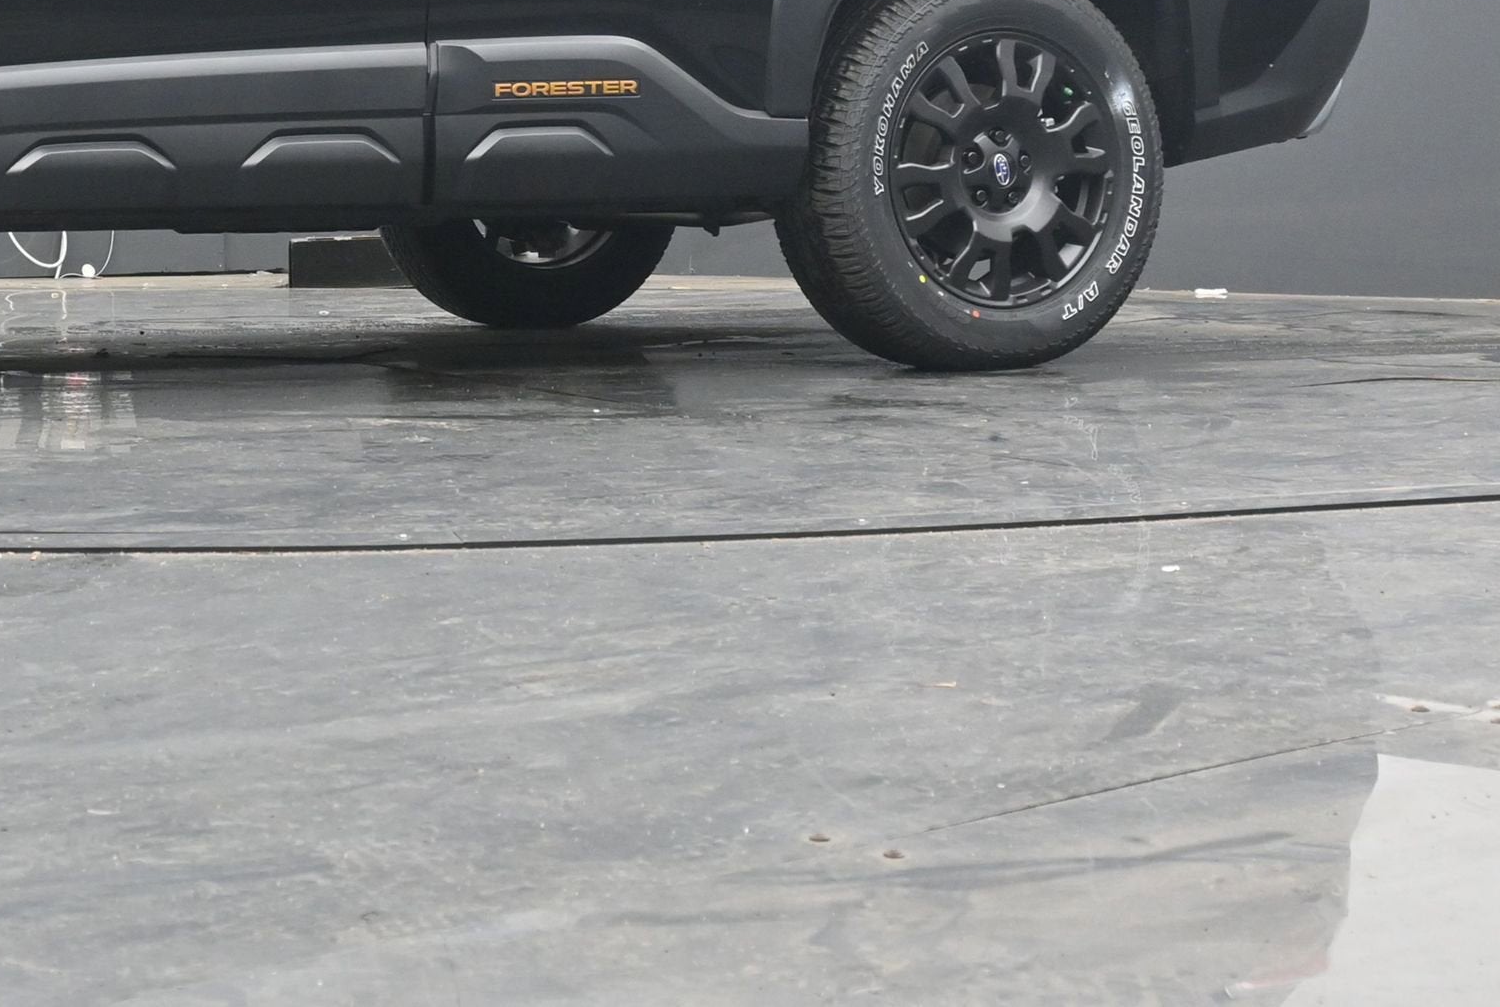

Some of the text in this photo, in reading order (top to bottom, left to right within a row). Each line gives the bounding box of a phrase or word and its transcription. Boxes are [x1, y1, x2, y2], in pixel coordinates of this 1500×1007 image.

[494, 80, 638, 98] FORESTER
[872, 41, 929, 196] YOKOHAMA
[1062, 99, 1146, 321] GEOLANDAR A/T
